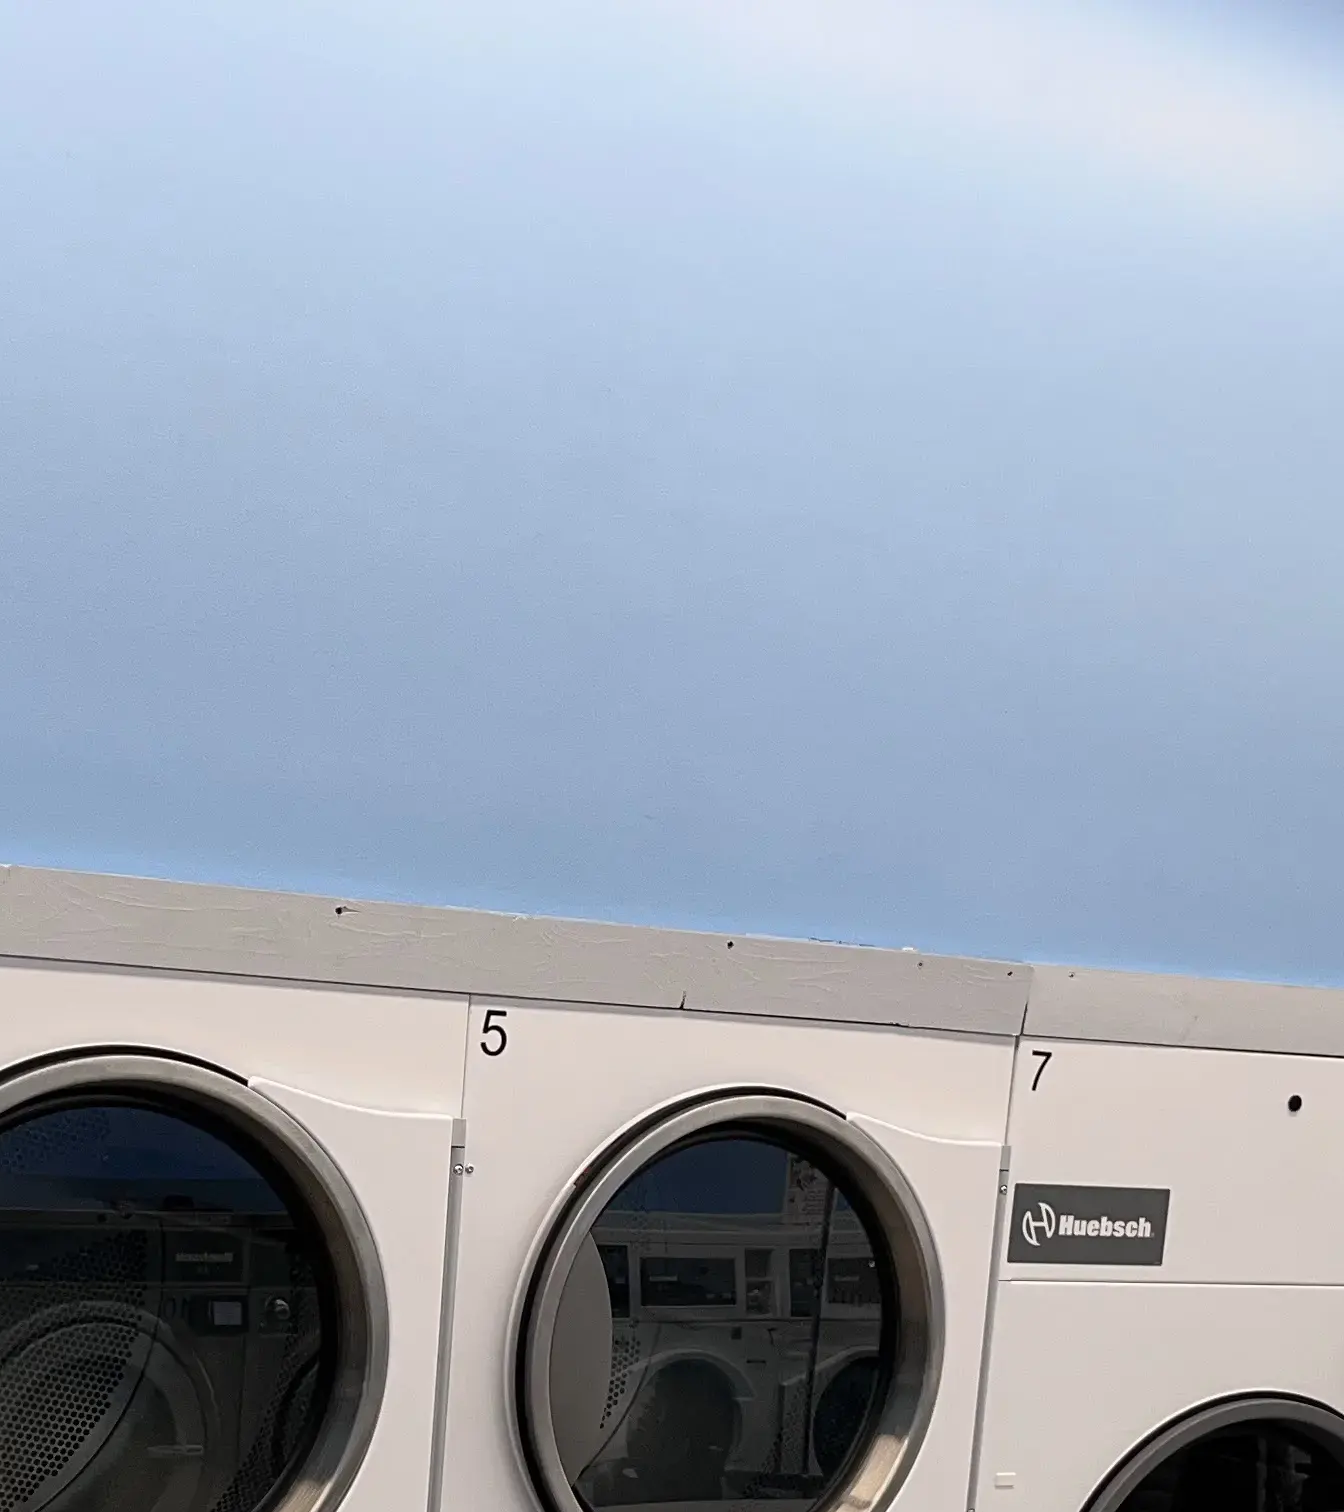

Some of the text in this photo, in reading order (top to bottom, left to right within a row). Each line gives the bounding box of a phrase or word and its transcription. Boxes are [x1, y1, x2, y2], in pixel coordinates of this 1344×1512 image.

[480, 1009, 508, 1057] 5
[1031, 1050, 1053, 1092] 7
[1058, 1214, 1152, 1238] Huebsch
